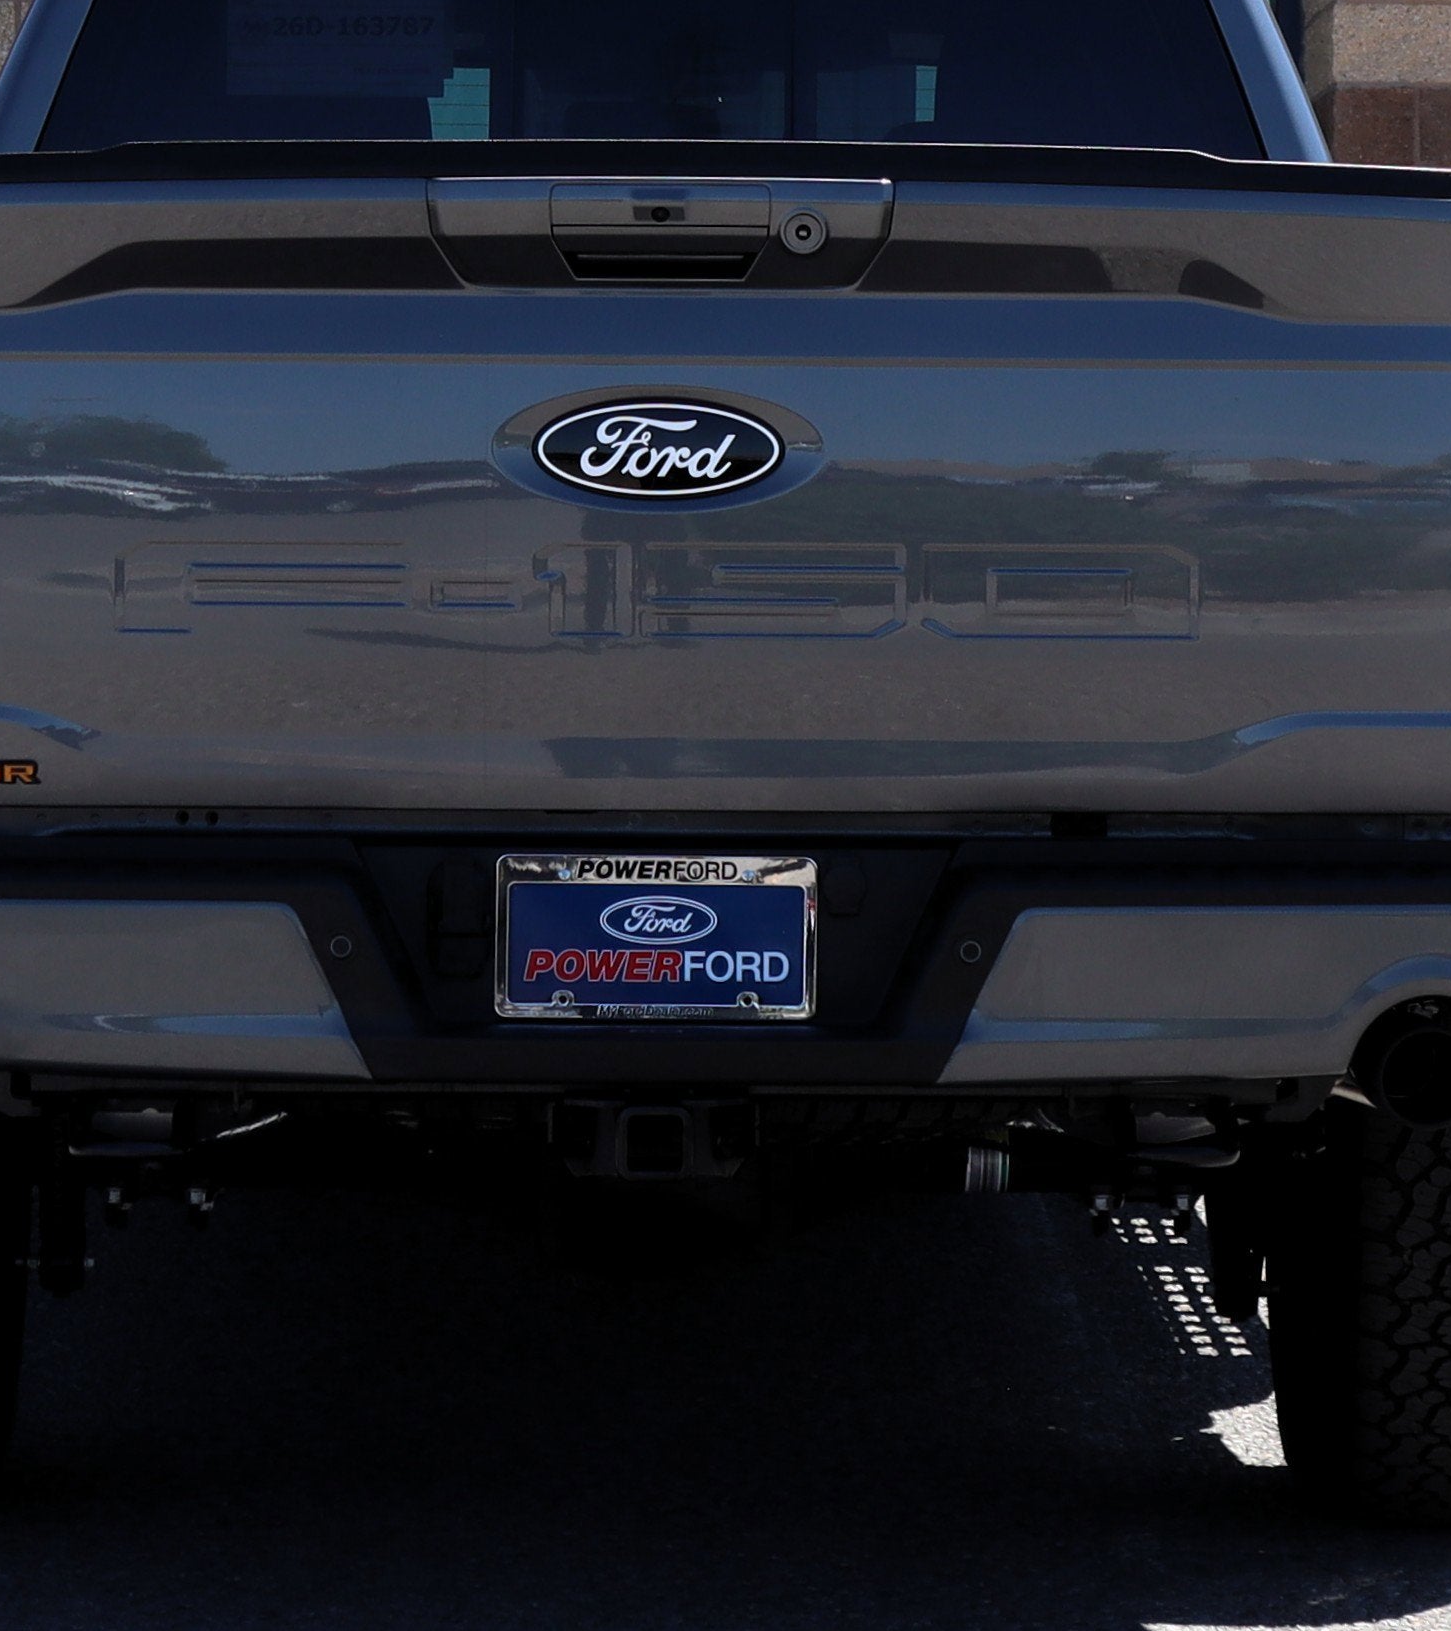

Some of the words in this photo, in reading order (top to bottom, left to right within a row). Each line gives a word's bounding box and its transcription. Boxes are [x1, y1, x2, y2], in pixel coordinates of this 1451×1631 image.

[579, 415, 737, 480] Ford
[113, 540, 1199, 640] F-150
[577, 860, 737, 881] POWERFORD
[623, 904, 692, 935] Ford
[523, 948, 790, 983] POWERFORD
